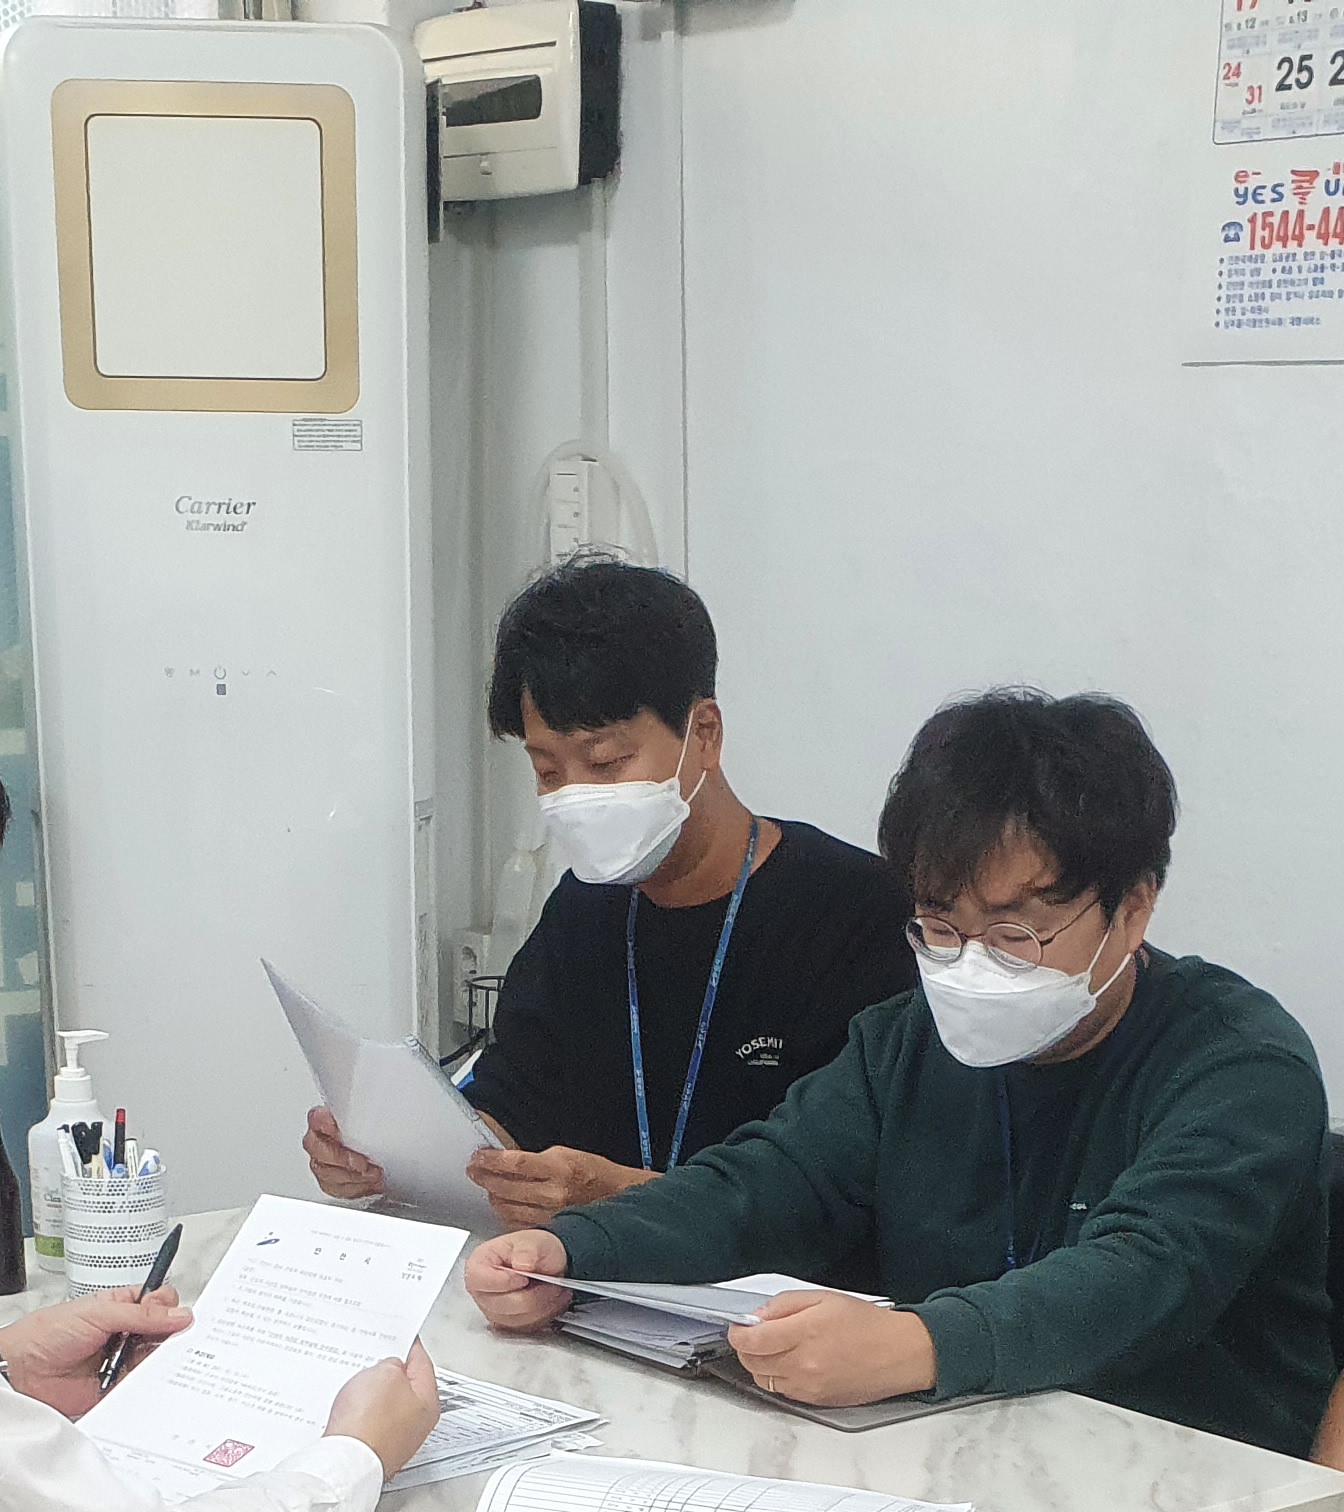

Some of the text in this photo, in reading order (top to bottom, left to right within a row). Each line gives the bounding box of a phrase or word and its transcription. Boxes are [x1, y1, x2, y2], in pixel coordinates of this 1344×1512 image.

[1222, 61, 1242, 81] 24
[1275, 54, 1314, 92] 25
[1245, 85, 1263, 105] 31
[174, 495, 256, 515] Carrier
